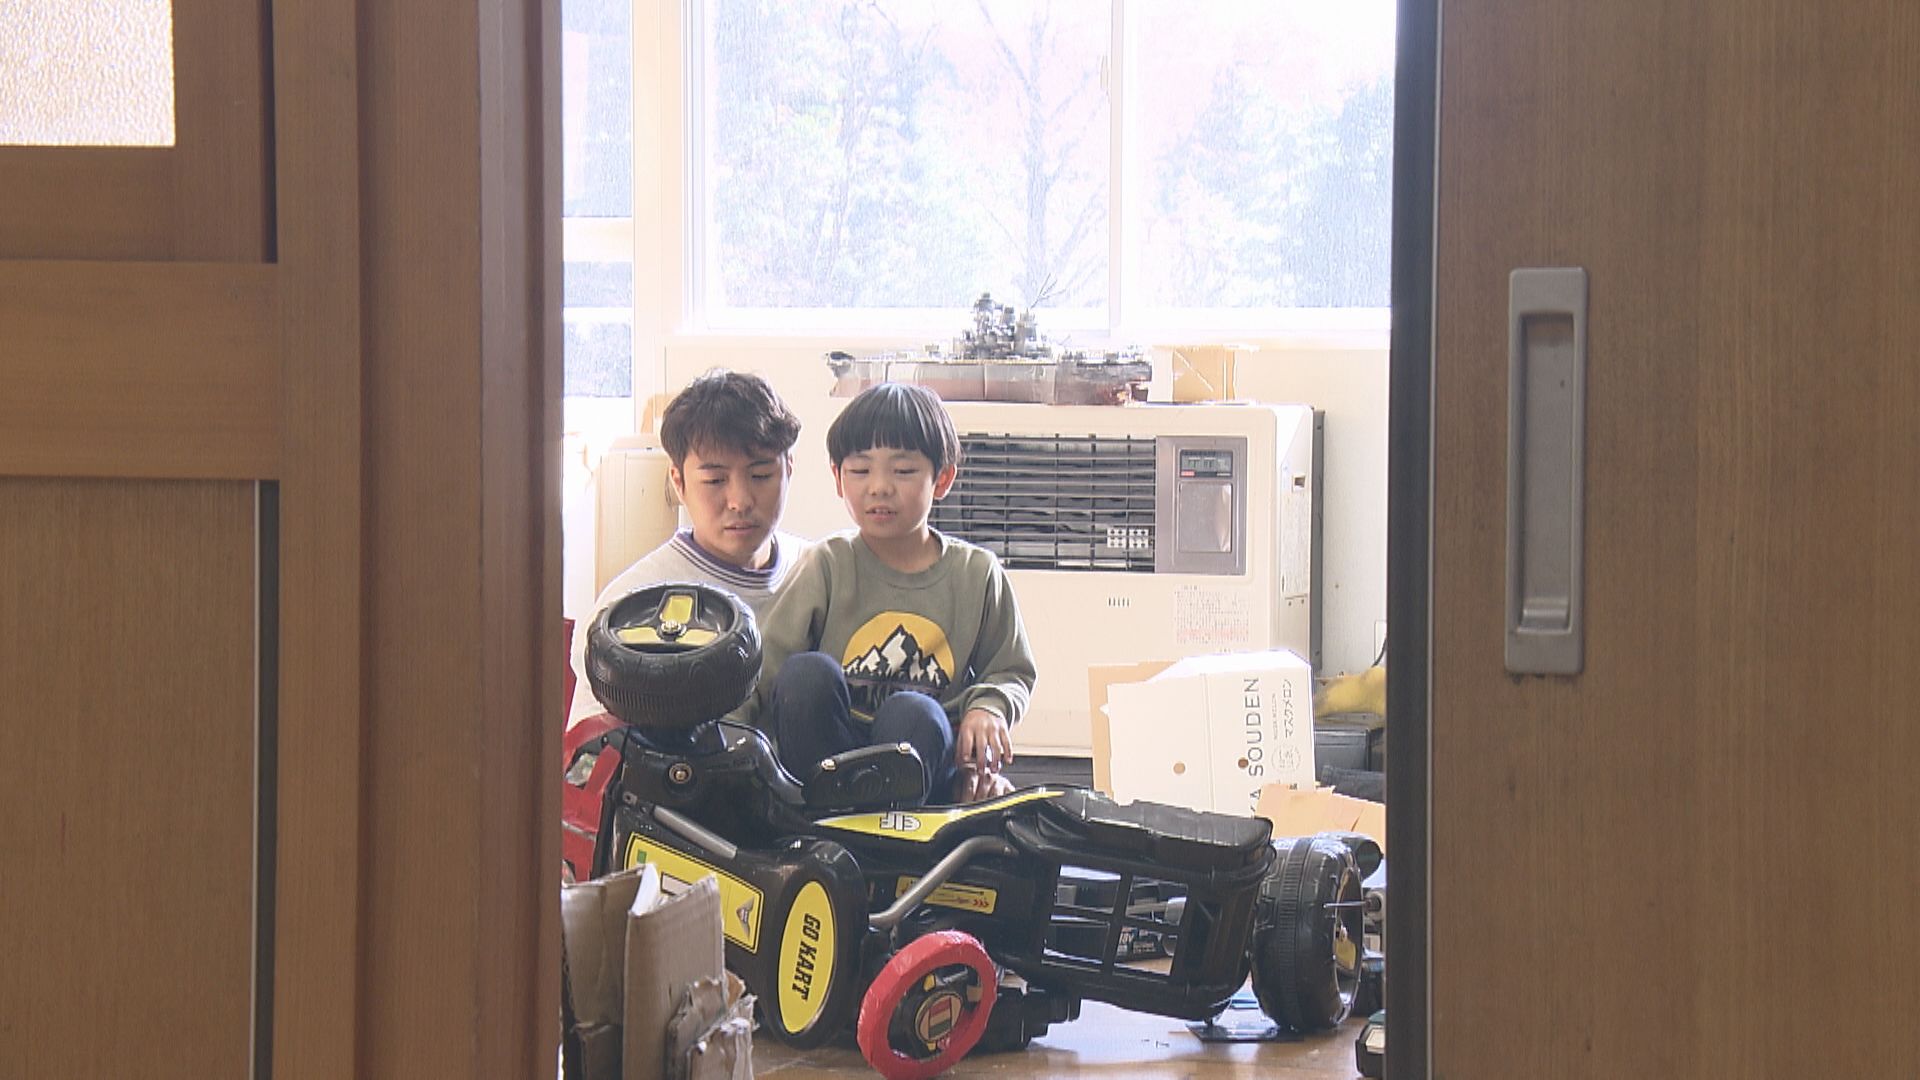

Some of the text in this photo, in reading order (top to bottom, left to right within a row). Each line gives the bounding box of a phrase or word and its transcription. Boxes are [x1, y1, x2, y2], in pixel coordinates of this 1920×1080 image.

[1243, 678, 1264, 777] SOUDEN
[791, 912, 822, 1002] GO KART
